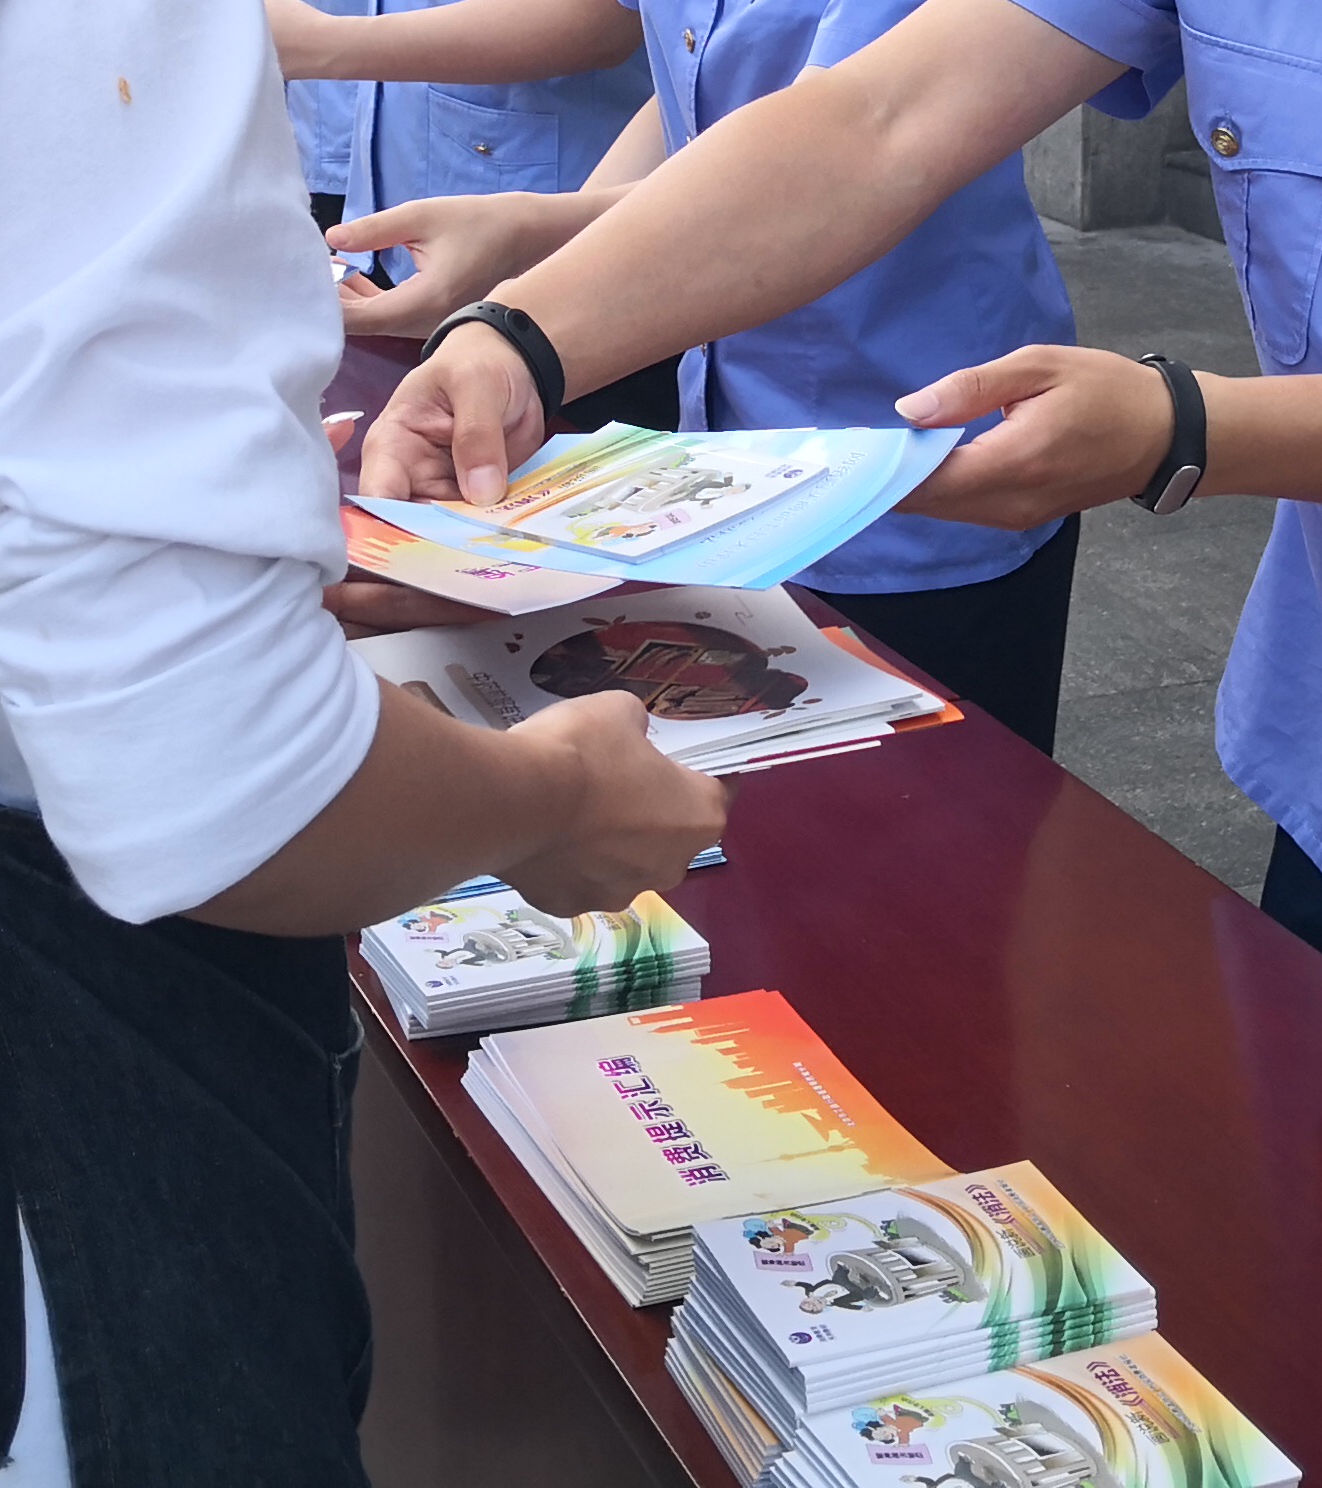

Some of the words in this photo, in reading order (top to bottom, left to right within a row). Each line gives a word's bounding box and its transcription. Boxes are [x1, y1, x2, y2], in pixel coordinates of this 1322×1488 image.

[598, 1056, 728, 1186] 消费提示汇编
